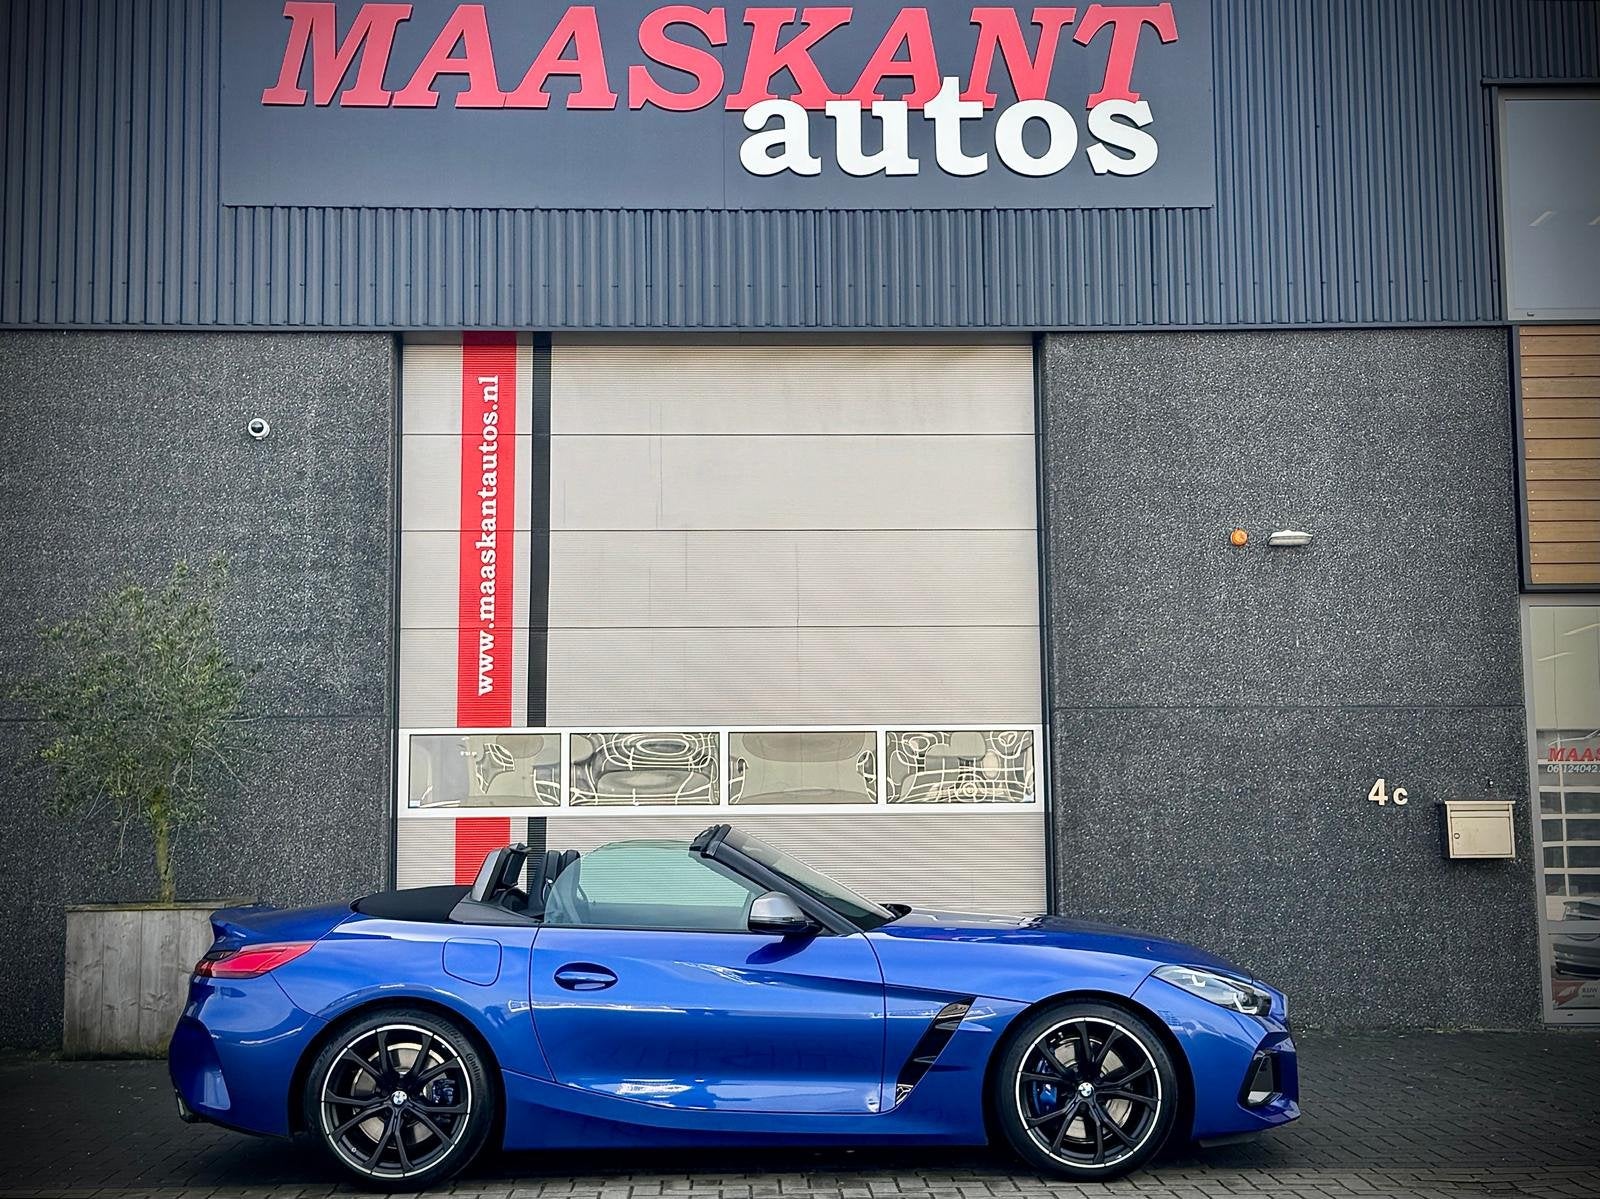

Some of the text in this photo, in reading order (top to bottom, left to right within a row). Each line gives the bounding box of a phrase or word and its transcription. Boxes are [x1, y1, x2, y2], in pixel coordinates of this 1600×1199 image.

[262, 2, 1178, 111] MAASKANT
[739, 76, 1159, 176] autos
[475, 374, 500, 697] www.maaskantautos.nl
